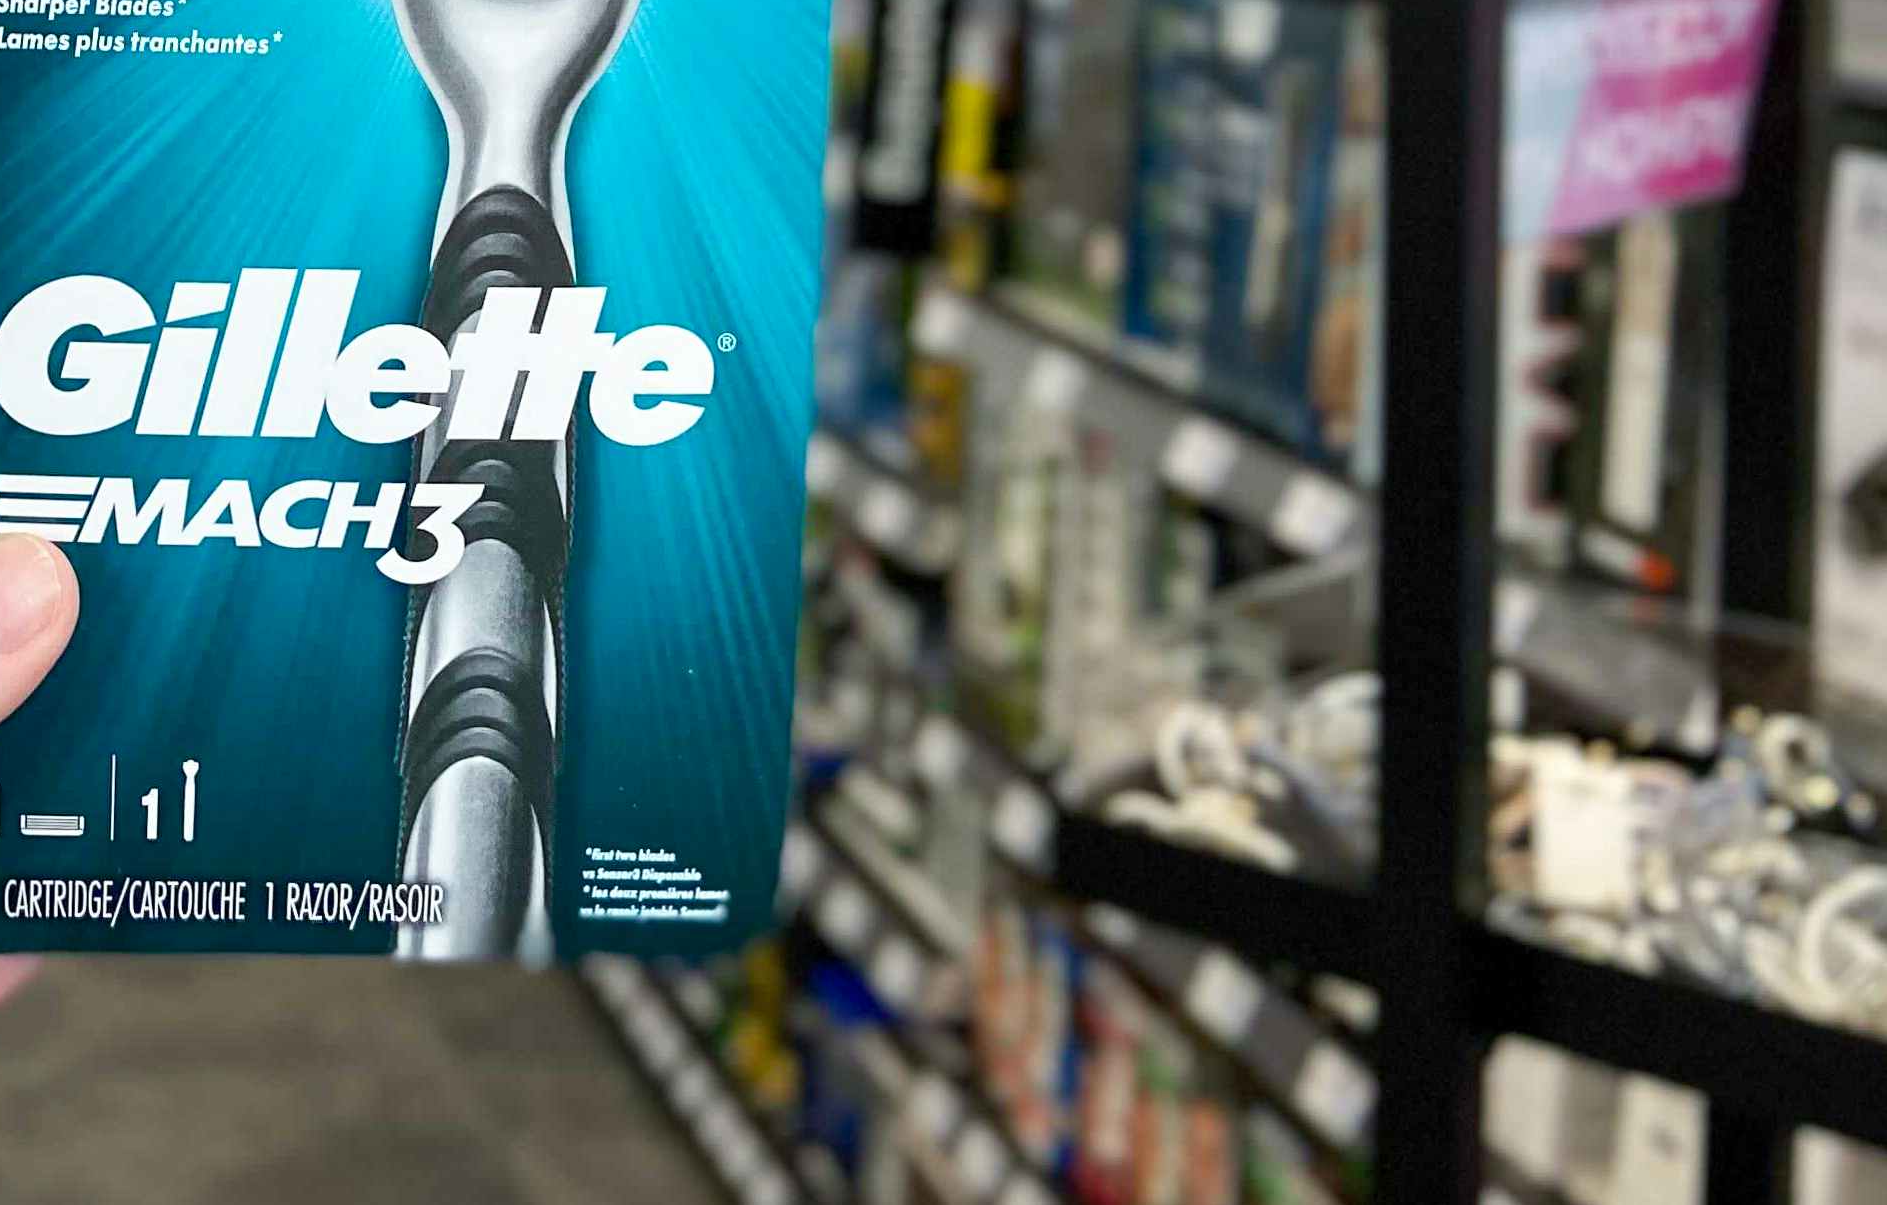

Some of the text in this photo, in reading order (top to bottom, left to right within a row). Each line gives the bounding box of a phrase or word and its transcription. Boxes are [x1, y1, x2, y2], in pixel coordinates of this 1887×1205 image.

[74, 27, 125, 57] plus
[77, 476, 485, 586] MACH3
[141, 788, 159, 840] 1
[615, 849, 637, 862] two
[639, 848, 676, 862] blades
[4, 877, 247, 928] CARTRIDGE/CARTOUCHE
[265, 882, 276, 922] 1
[286, 880, 444, 931] RAZOR/RASOIR
